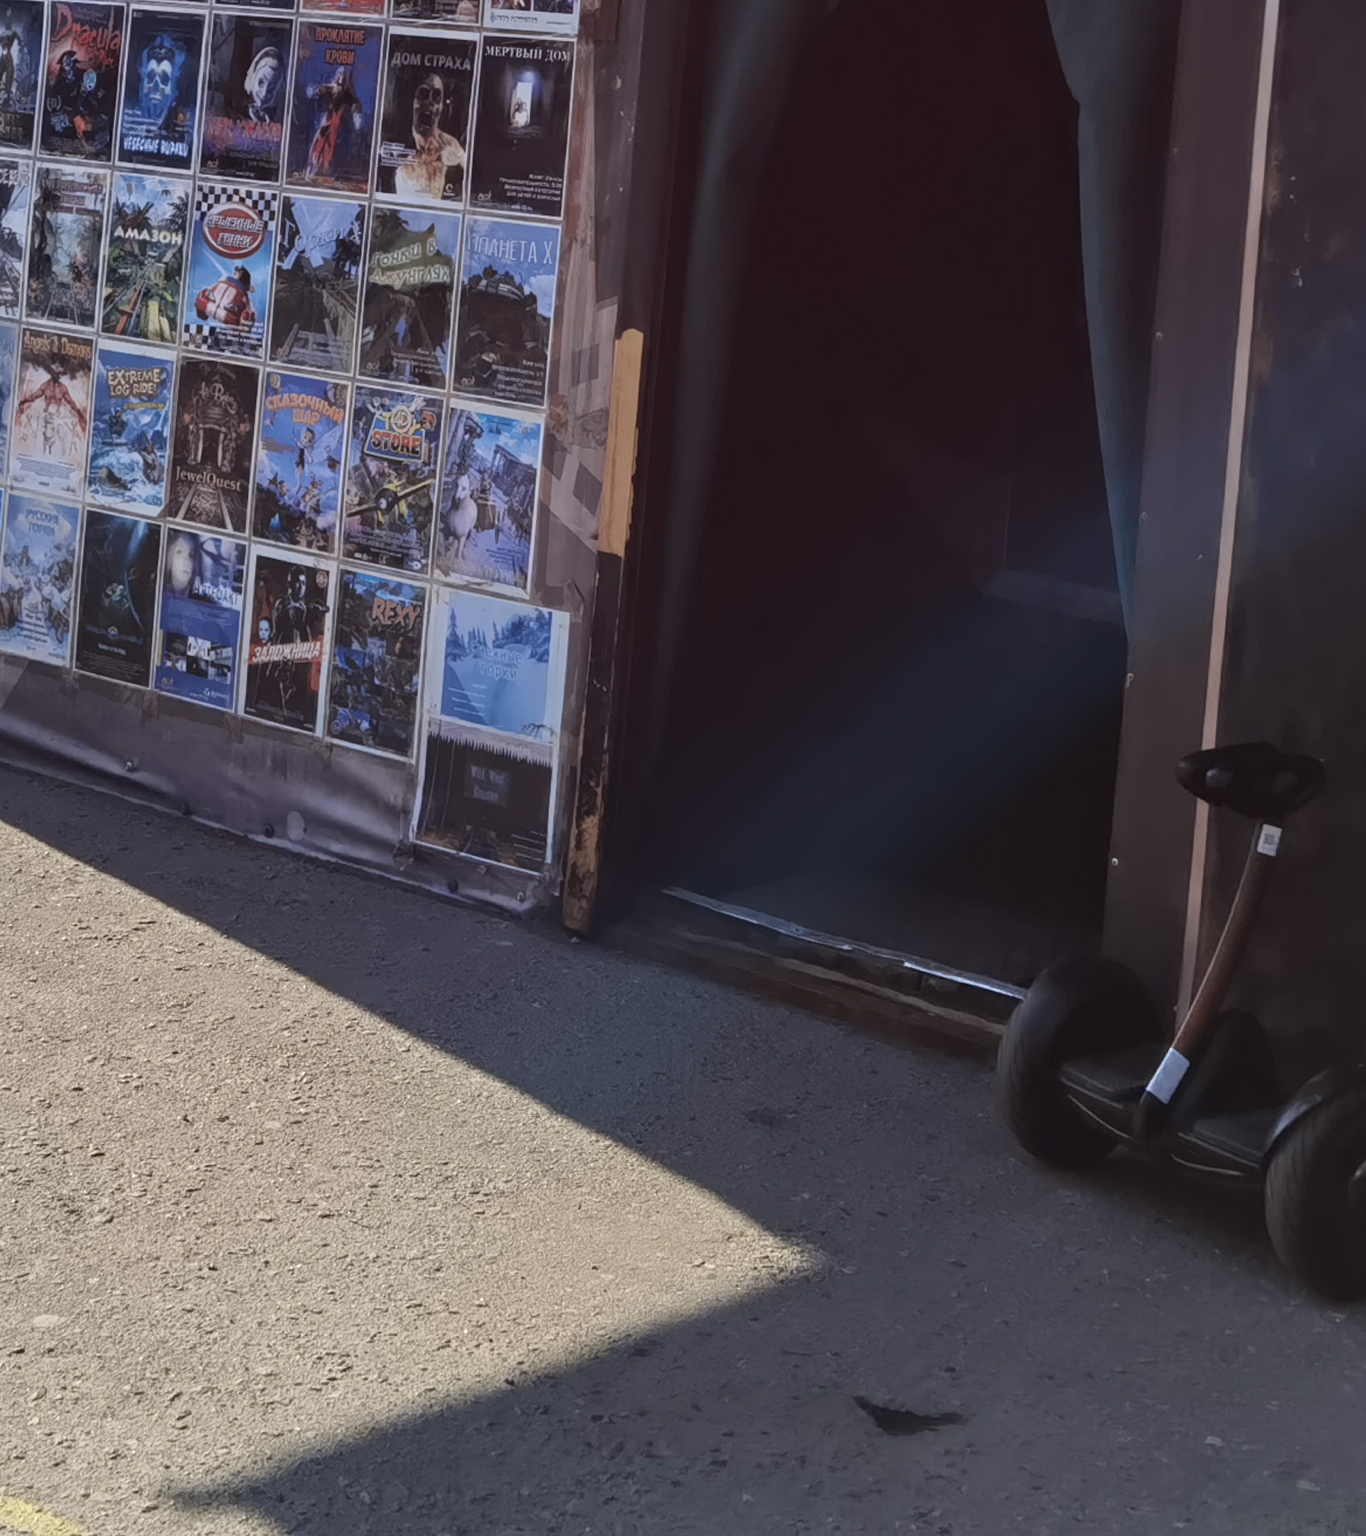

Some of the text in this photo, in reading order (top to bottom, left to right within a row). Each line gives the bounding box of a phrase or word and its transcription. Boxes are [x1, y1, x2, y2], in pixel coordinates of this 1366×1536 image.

[51, 3, 122, 52] Dracula
[315, 27, 365, 45] ПРОКЛЯТИЕ
[325, 48, 356, 65] КРОВИ
[391, 52, 471, 71] ДОМ СТРАХА
[545, 49, 571, 62] ДОМ
[113, 225, 183, 247] АМАЗОН
[467, 233, 538, 264] ПЛАНЕТА
[110, 383, 131, 396] LOG
[371, 429, 422, 456] STORE
[372, 597, 421, 629] REXY
[252, 641, 321, 663] ЗАЛОЖНИЦА
